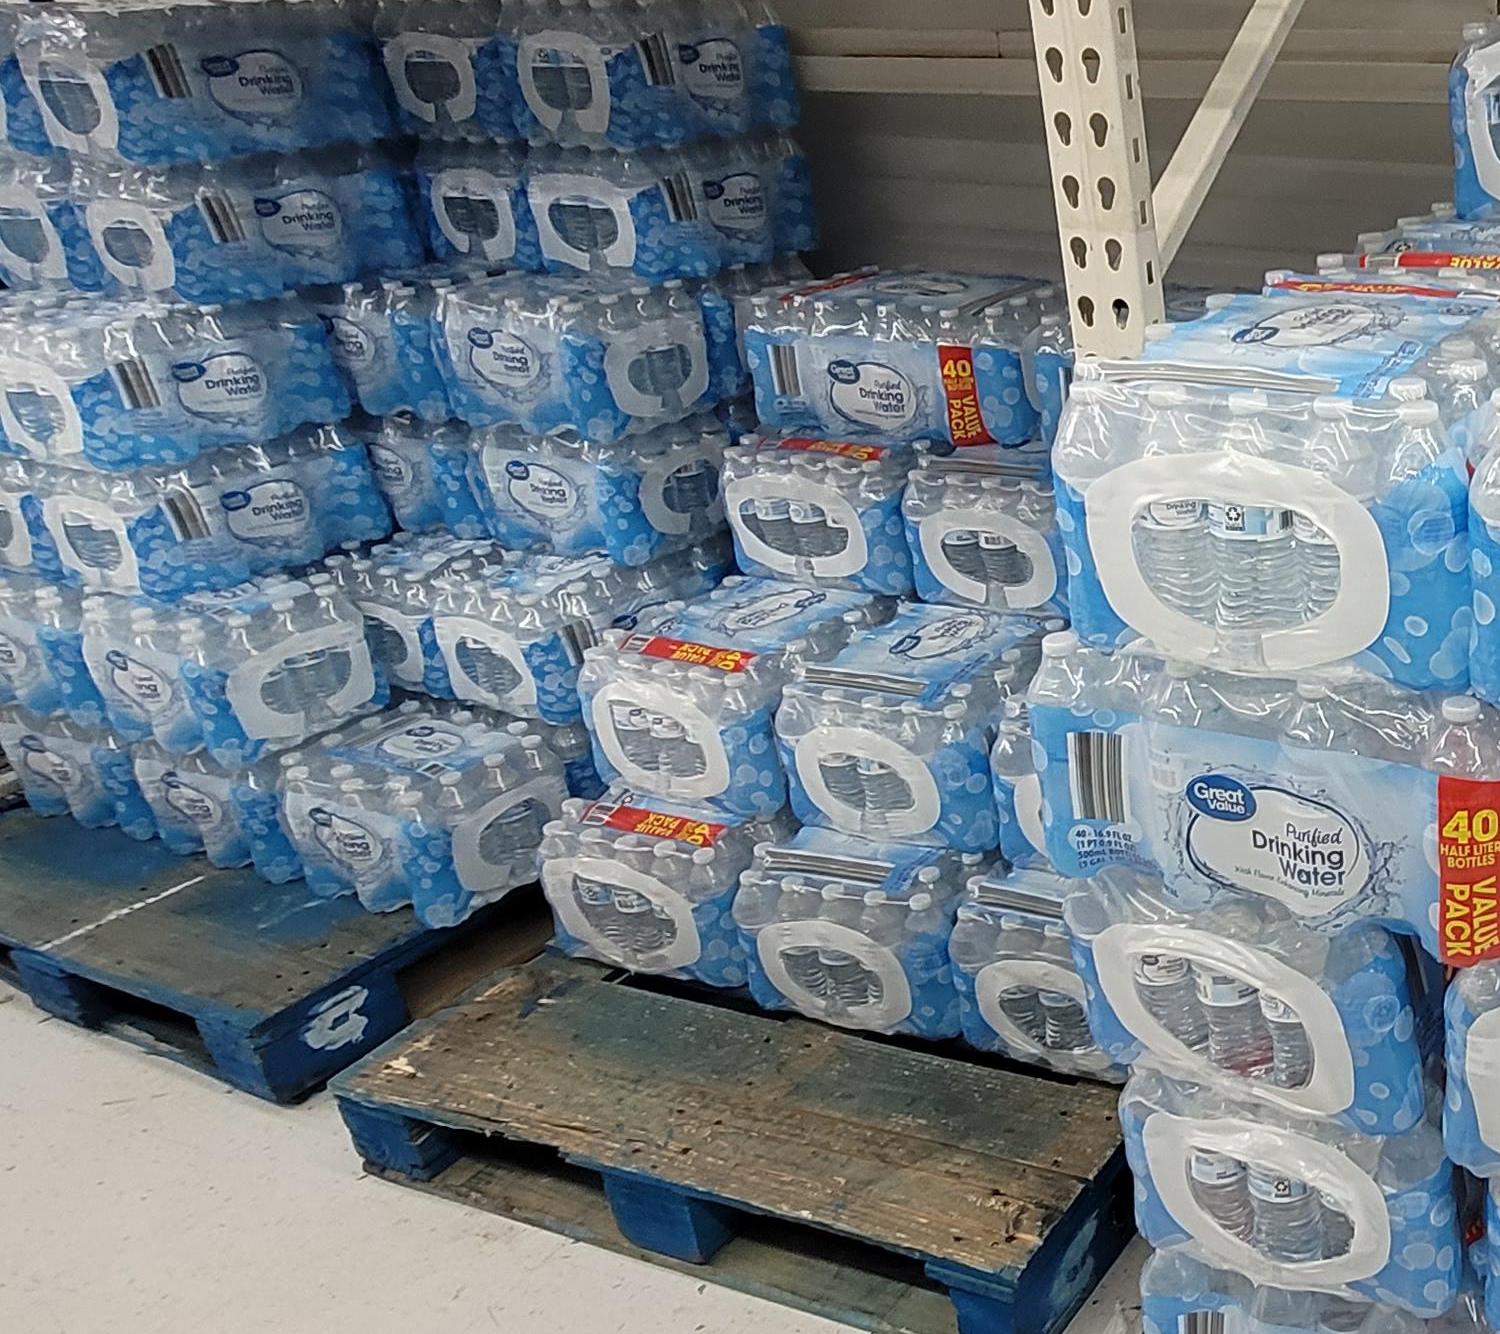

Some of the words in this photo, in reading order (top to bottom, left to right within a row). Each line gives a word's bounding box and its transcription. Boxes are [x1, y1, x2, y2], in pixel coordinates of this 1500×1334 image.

[238, 73, 294, 89] Drinking
[282, 210, 334, 225] Drinking
[943, 359, 971, 377] 40
[205, 373, 260, 390] Drinking
[859, 386, 904, 404] Drinking
[873, 401, 905, 414] Water
[949, 399, 966, 440] PACK
[961, 395, 984, 439] VALUE
[252, 498, 304, 517] Drinking
[1194, 783, 1245, 805] Great
[1207, 799, 1245, 814] Value
[648, 813, 681, 829] PACK
[1442, 809, 1499, 844] 40
[1286, 823, 1343, 848] Purified
[1252, 830, 1345, 870] Drinking
[1440, 843, 1471, 857] HALF
[1447, 854, 1496, 868] BOTTLES
[1279, 857, 1347, 887] Water
[1445, 883, 1472, 957] PACK
[1472, 875, 1500, 956] VALUE
